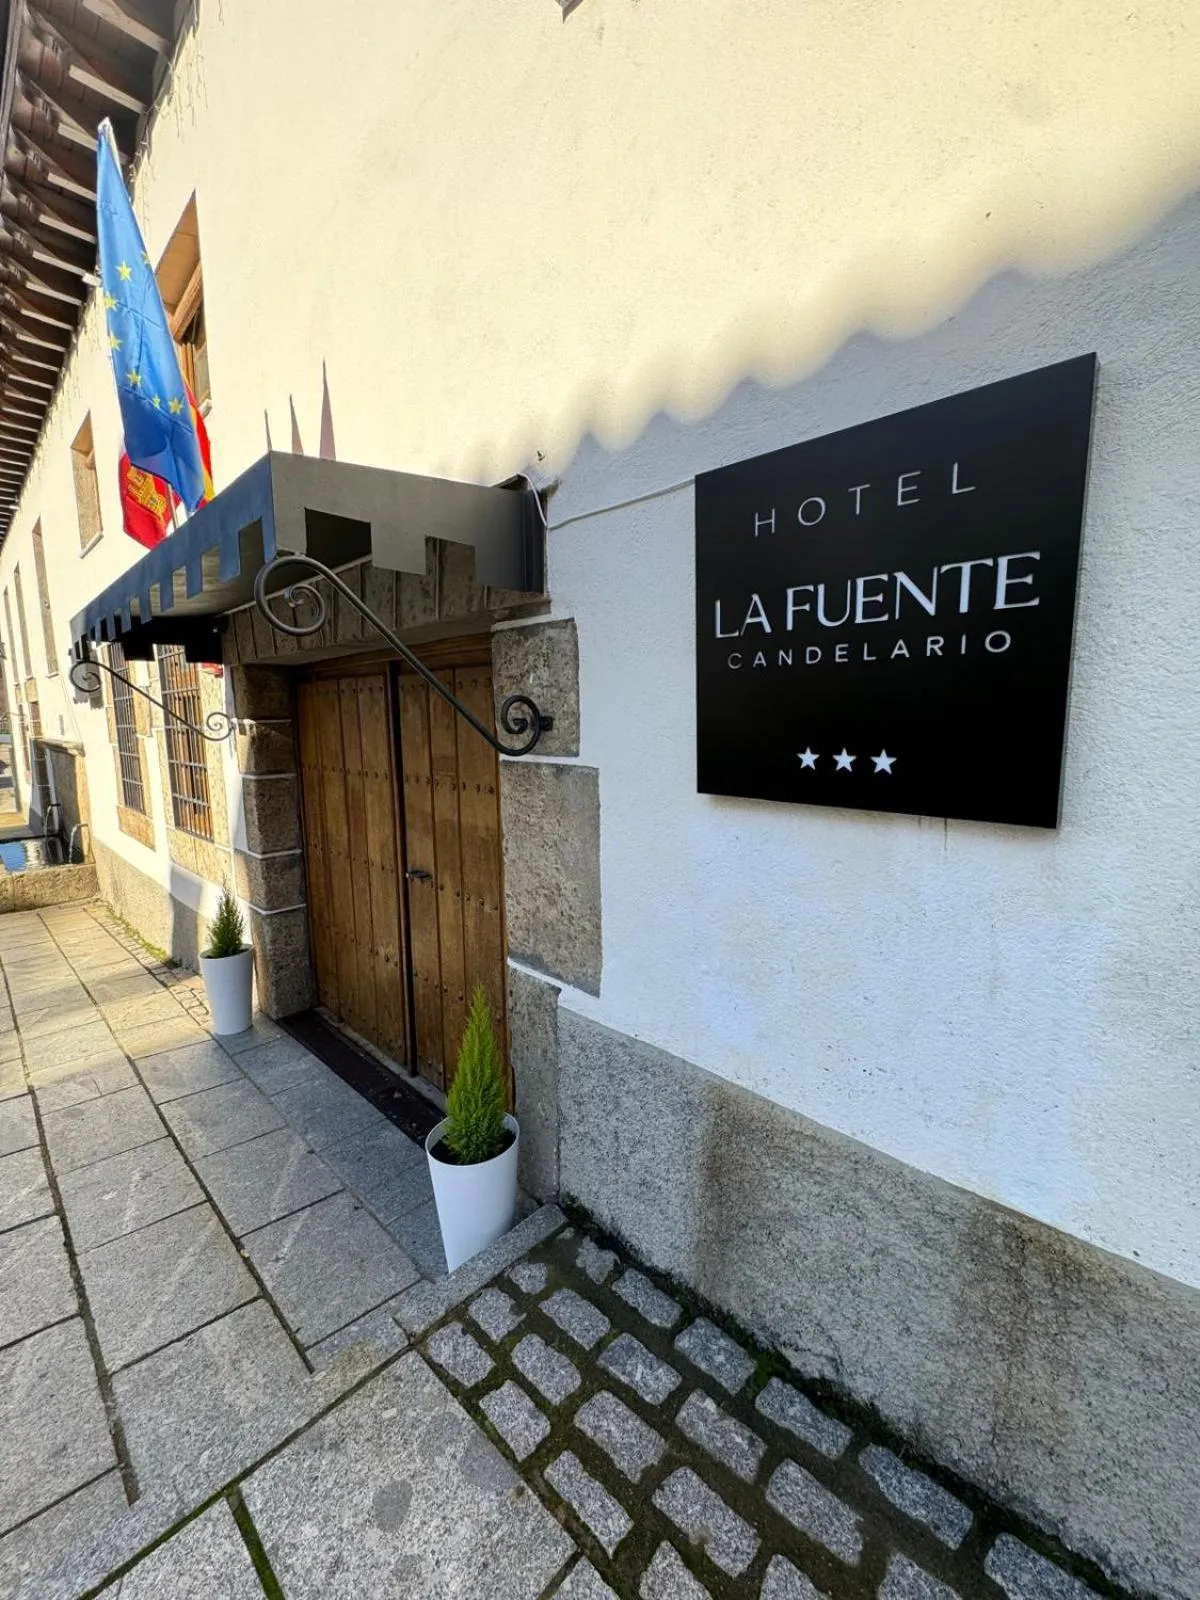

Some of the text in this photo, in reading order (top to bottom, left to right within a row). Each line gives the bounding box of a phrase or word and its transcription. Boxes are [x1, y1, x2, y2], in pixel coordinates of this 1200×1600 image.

[754, 462, 976, 537] HOTEL
[714, 551, 1041, 639] LA FUENTE
[727, 630, 1011, 669] CANDELARIO
